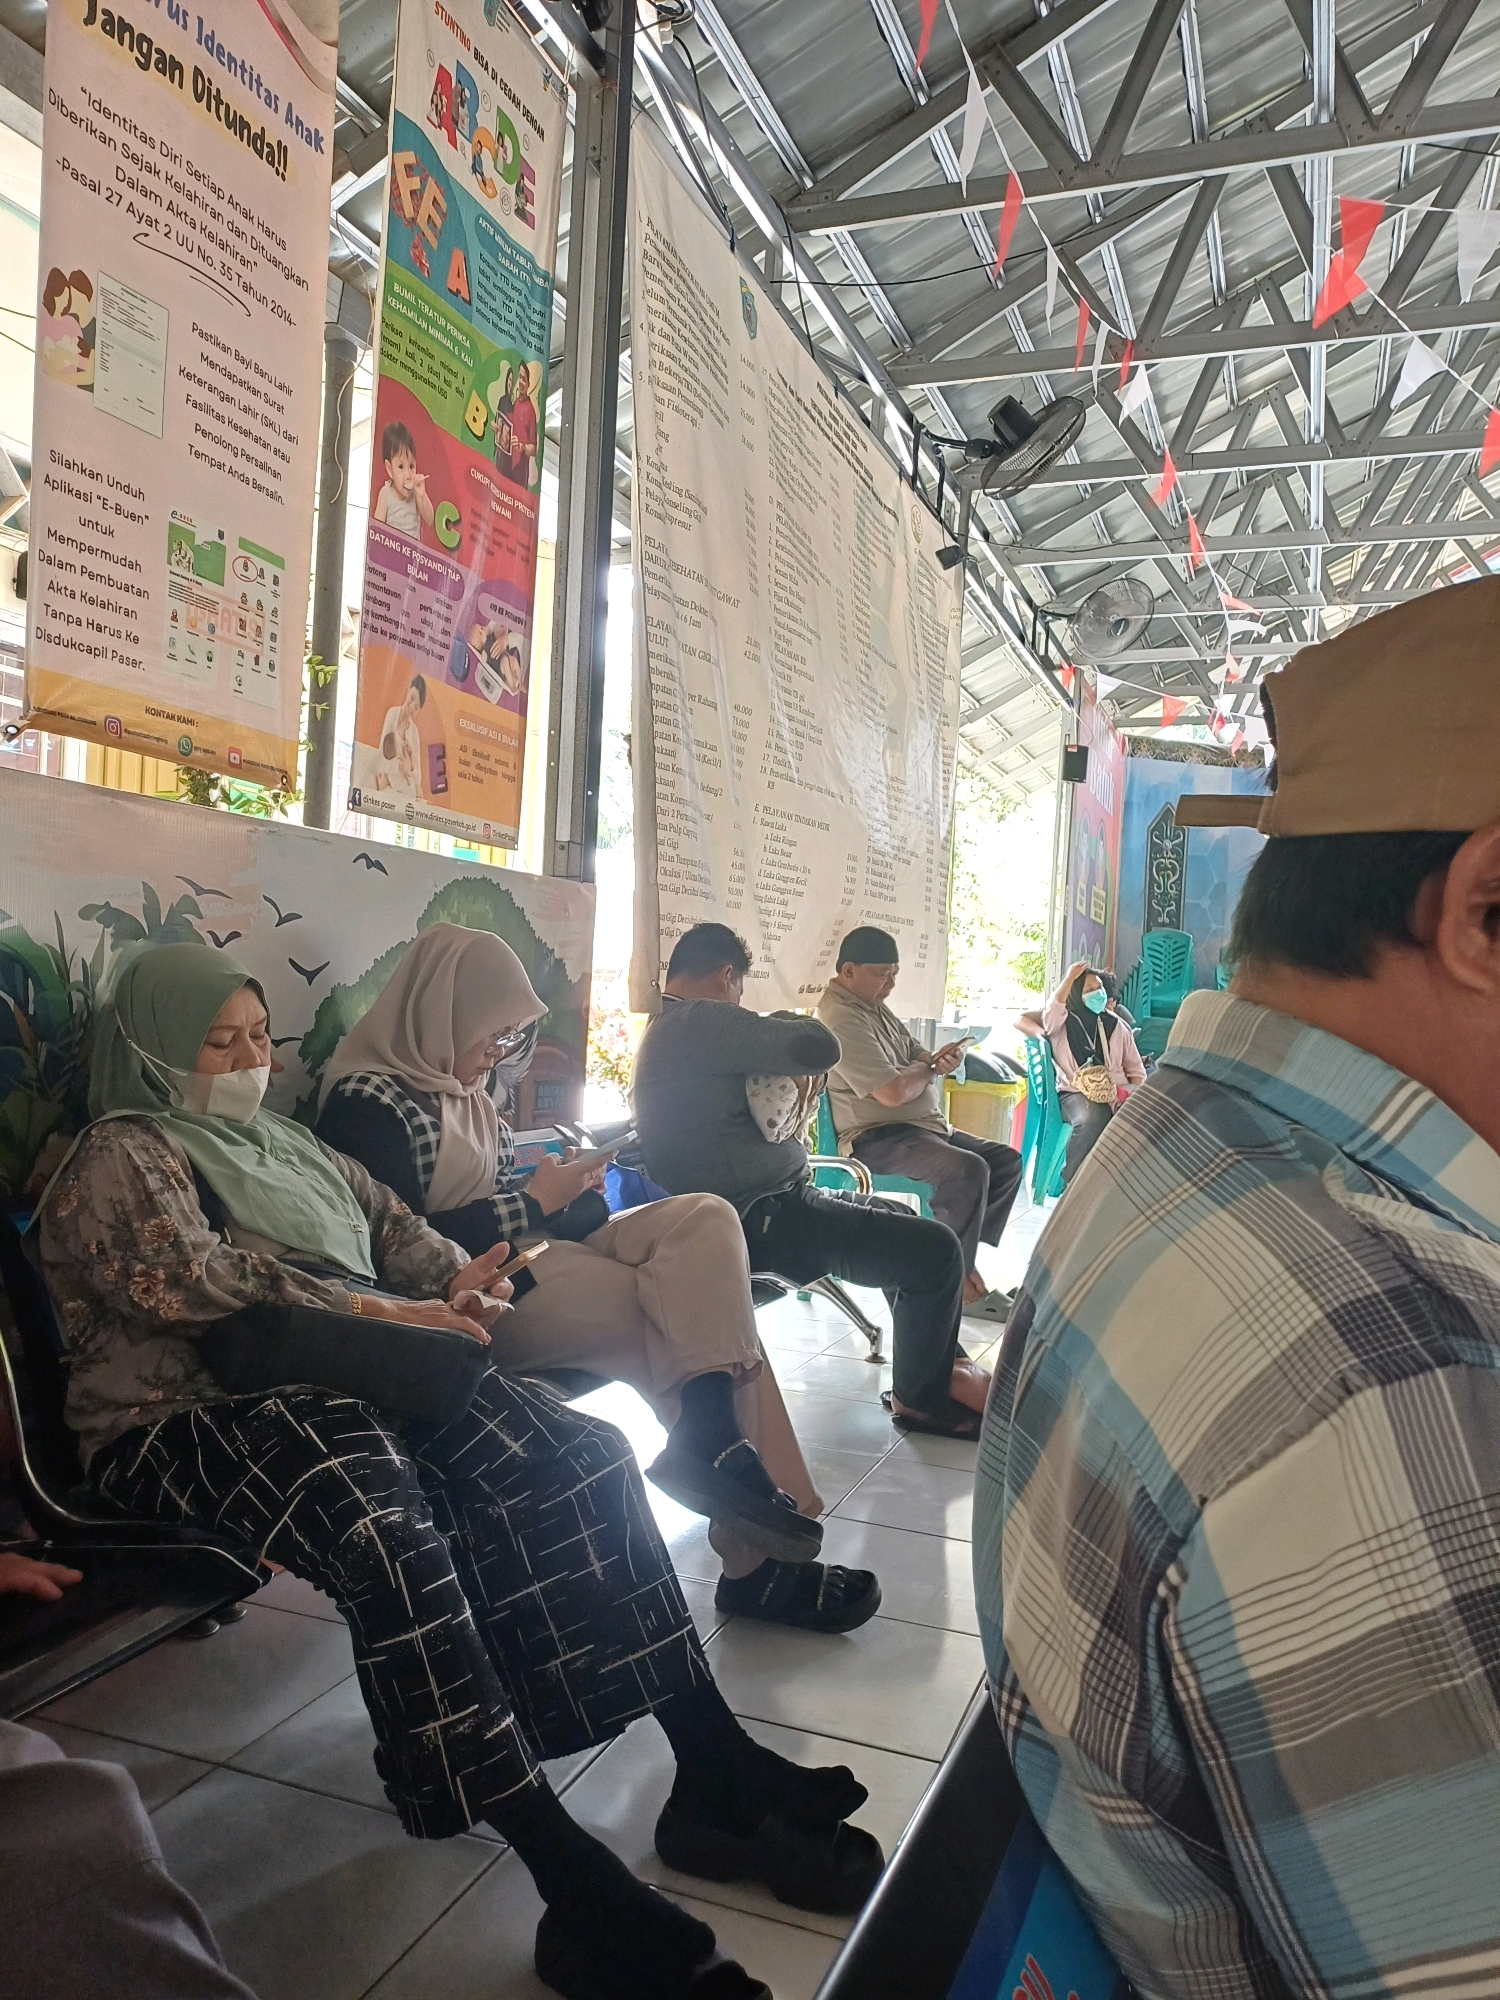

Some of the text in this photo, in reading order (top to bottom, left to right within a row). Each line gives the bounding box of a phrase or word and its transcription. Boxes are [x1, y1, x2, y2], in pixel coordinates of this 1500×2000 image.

[196, 15, 279, 114] Identitas
[285, 102, 324, 155] Anak
[434, 1, 545, 143] STUNTING BISA DI CEGAH DENGAN
[82, 0, 288, 182] Jangan Ditunda!!
[48, 87, 309, 291] Diberikan Sejak Kelahiran dan Dituangkan
[115, 165, 163, 208] Dalam
[166, 199, 197, 230] Akta
[159, 140, 183, 169] Diri
[185, 160, 225, 201] Setiap
[227, 193, 255, 225] Anak
[257, 216, 287, 251] Harus
[56, 156, 297, 327] -Pasal 27 Ayat 2 UU No. 35 Tahun 2014-
[478, 216, 494, 237] AKTIF
[494, 229, 512, 256] MINUM
[497, 252, 519, 277] DARAH
[393, 282, 471, 349] BUMIL TERATUR PERIKSA
[387, 294, 473, 368] KEHAMILAN MINIMAL 6 KALI
[191, 321, 294, 397] Pastikan Bayi Baru Lahir
[408, 334, 436, 362] kehamilan
[419, 358, 424, 368] 2
[200, 351, 285, 415] Mendapatkan Surat
[399, 362, 438, 390] menggunakan
[437, 386, 448, 400] USG
[178, 364, 299, 446] Keterangan Lahir (SKL) dari
[185, 393, 291, 464] Fasilitas Kesehatan atau
[194, 422, 282, 482] Penolong Persalinan
[43, 473, 93, 504] Aplikasi
[49, 449, 145, 502] Silahkan Unduh
[187, 443, 285, 506] Tempat Anda Bersalin.
[470, 467, 490, 490] CUKUPI
[514, 500, 535, 520] PROTEIN
[491, 499, 512, 520] HEWANI
[78, 516, 115, 539] untuk
[47, 526, 142, 573] Mempermudah
[369, 529, 461, 583] DATANG KE POSYANDU TIAP
[38, 548, 77, 575] Dalam
[80, 564, 150, 600] Pembuatan
[407, 563, 429, 583] BULAN
[47, 579, 138, 620] Akta Kelahiran
[716, 590, 741, 609] GAWAT
[43, 602, 140, 645] Tanpa Harus Ke
[688, 616, 702, 628] Jam
[35, 626, 108, 660] Disdukcapil
[111, 649, 145, 671] Paser.
[698, 650, 712, 663] GIGI
[145, 705, 195, 727] KONTAK KAMI
[687, 692, 718, 711] per Rahang
[733, 703, 753, 716] 40.000
[459, 718, 519, 748] EKSKLUSIF ASI 6 BULAN
[732, 715, 750, 729] 75.000
[762, 752, 771, 762] 17.
[764, 740, 772, 750] 16.
[767, 780, 775, 789] KB
[1089, 749, 1114, 817] Batuk
[362, 795, 396, 812] dinkes paser
[656, 805, 670, 817] Dari
[762, 805, 793, 821] PELAYANAN
[794, 811, 817, 828] TINDAKAN
[668, 822, 682, 836] Pulp
[760, 818, 775, 829] Rawat
[666, 837, 679, 850] Gigi
[782, 836, 797, 847] Ringan
[668, 883, 681, 895] Gigi
[664, 927, 675, 938] Gigi
[665, 913, 677, 925] Gigi
